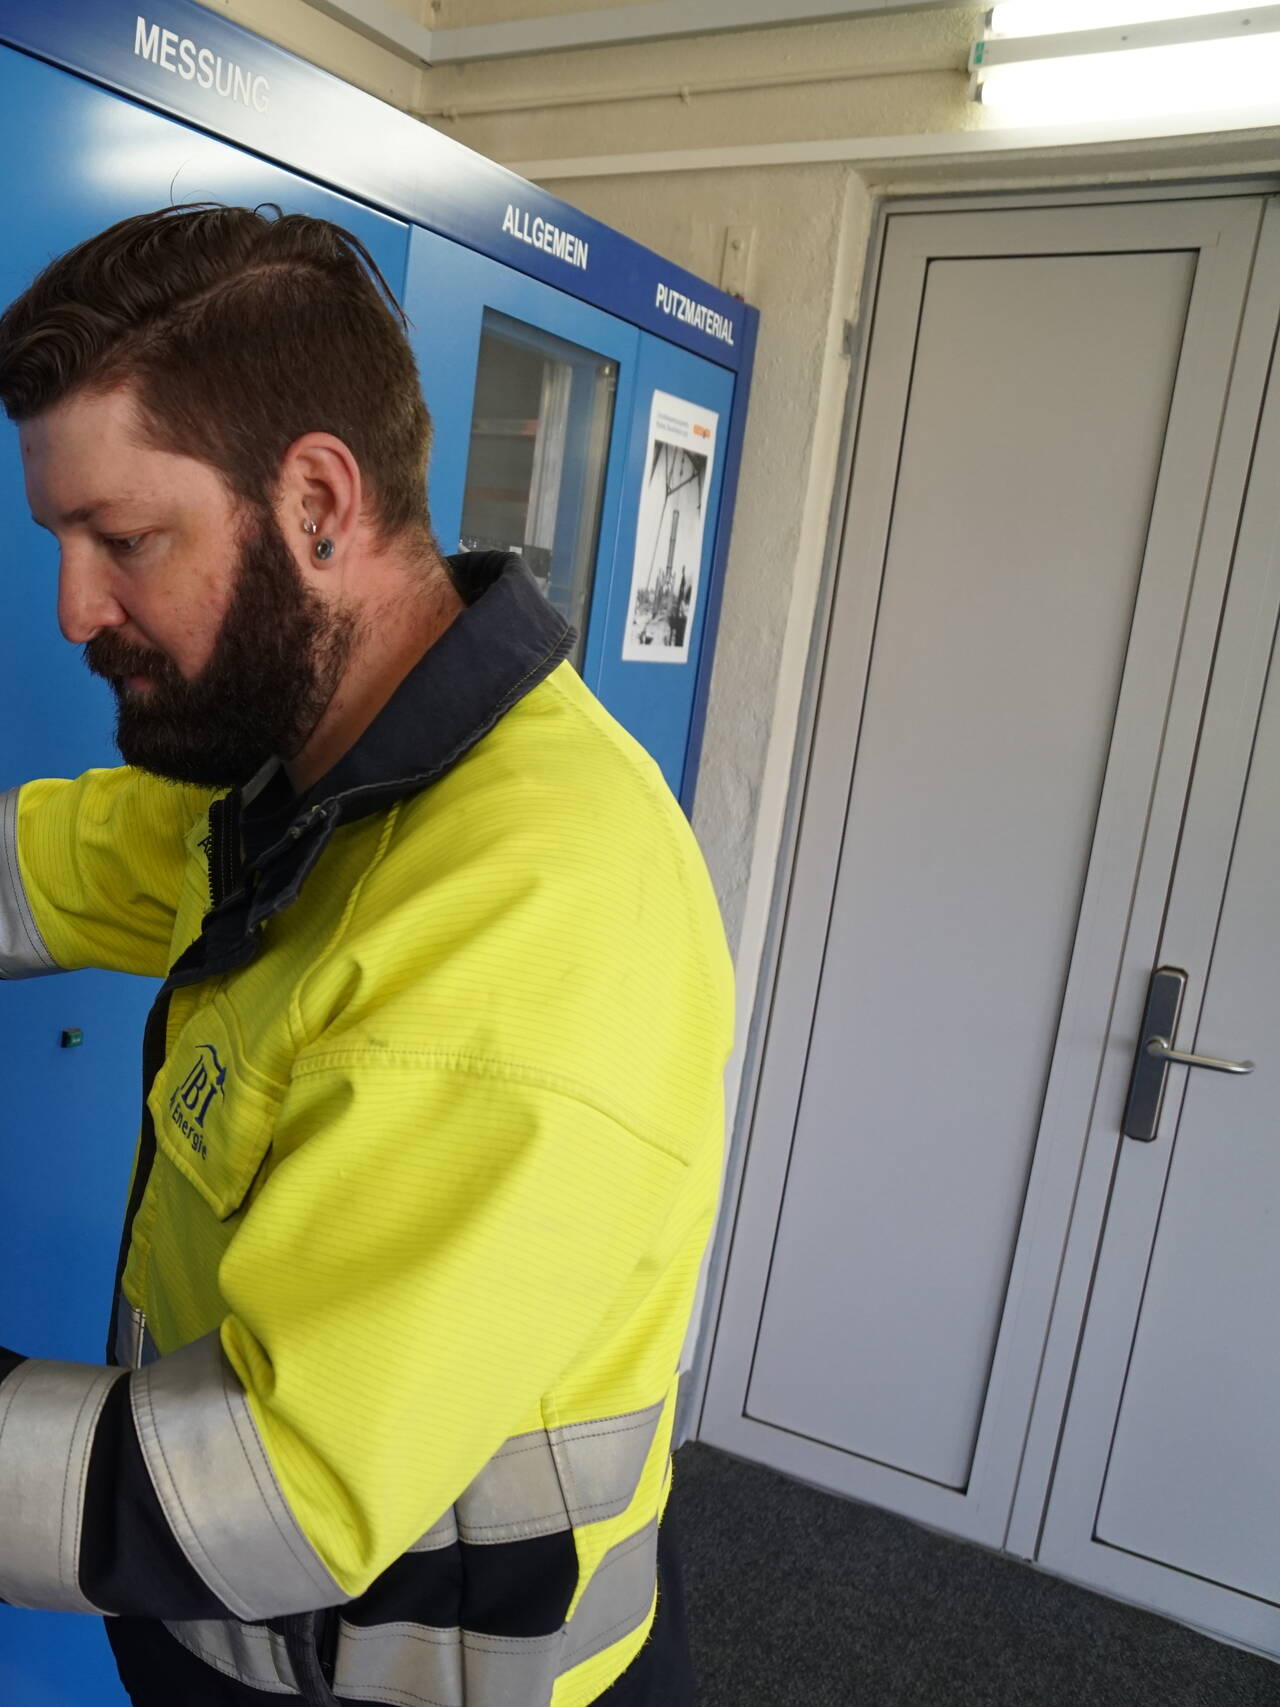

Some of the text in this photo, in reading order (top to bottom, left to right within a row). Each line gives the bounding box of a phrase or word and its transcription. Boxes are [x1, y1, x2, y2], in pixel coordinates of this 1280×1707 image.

[134, 16, 270, 114] MESSUNG
[502, 204, 589, 271] ALLGEMEIN
[655, 282, 735, 346] PUTZMATERIAL
[172, 1103, 208, 1160] Energie
